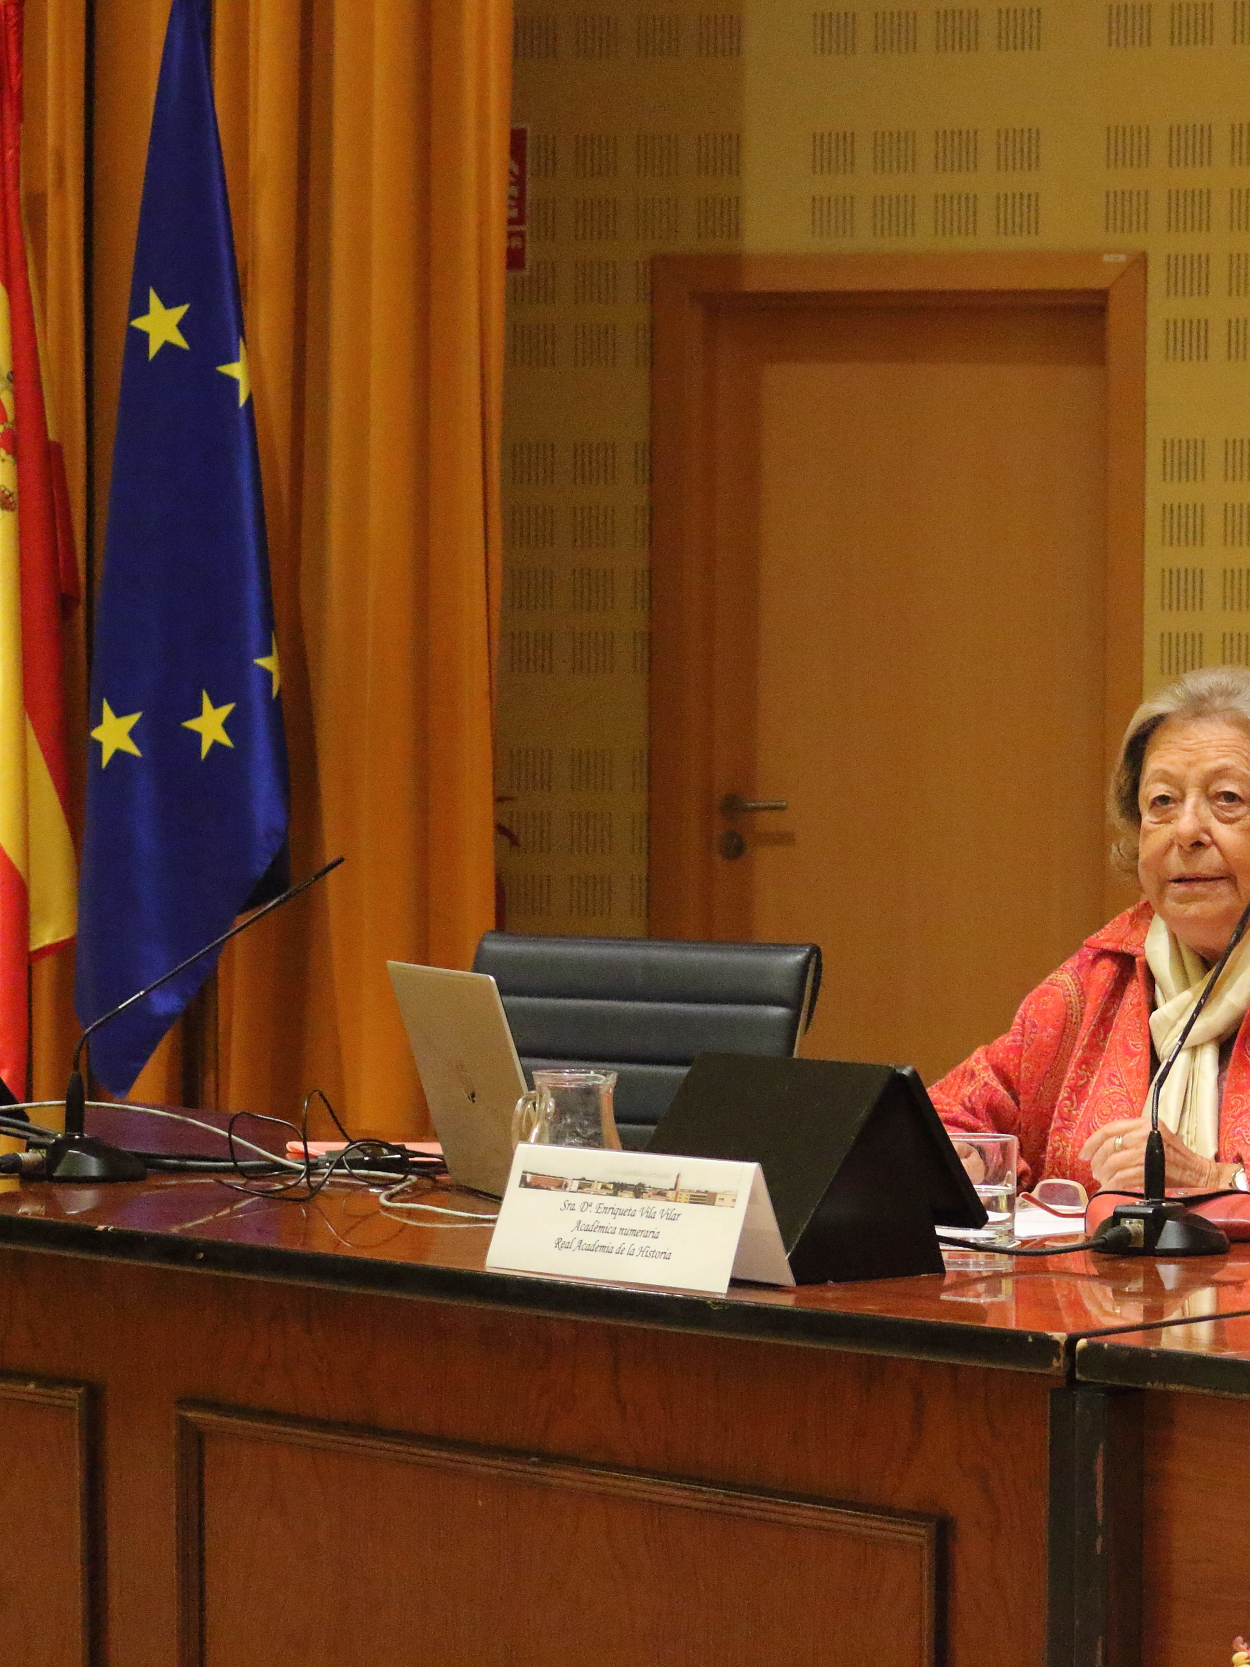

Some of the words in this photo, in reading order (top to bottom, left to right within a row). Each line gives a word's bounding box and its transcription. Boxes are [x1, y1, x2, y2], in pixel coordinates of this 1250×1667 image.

[560, 1199, 576, 1211] Sra.
[595, 1202, 637, 1219] Enriqueta
[639, 1206, 657, 1219] Vila
[658, 1207, 682, 1221] Vilar
[570, 1219, 617, 1235] Académica
[618, 1227, 660, 1239] numeraria
[554, 1237, 576, 1251] Real
[572, 1239, 614, 1253] Academia
[615, 1242, 625, 1255] de
[626, 1243, 636, 1256] la
[635, 1245, 672, 1260] Historia
